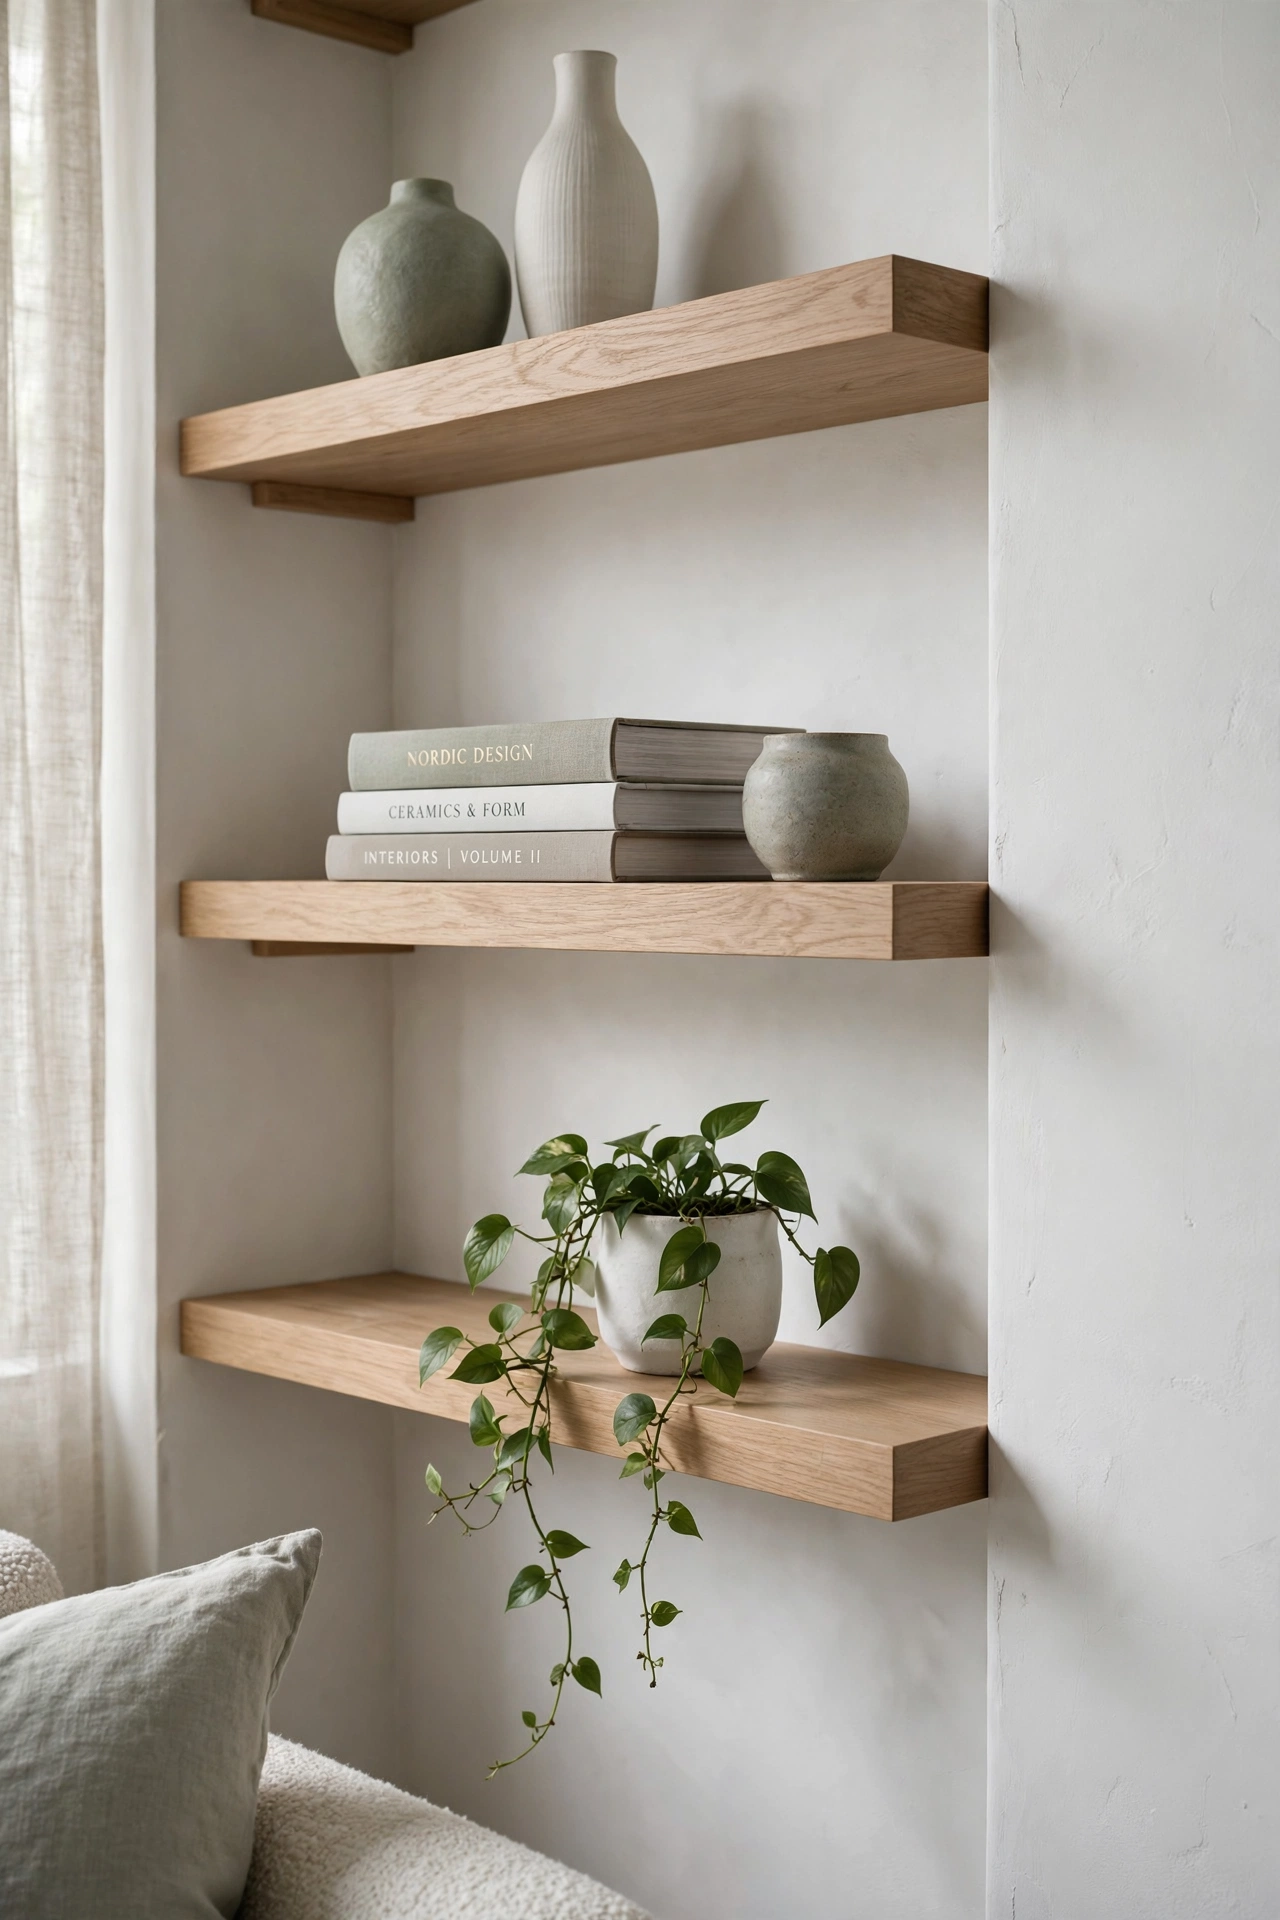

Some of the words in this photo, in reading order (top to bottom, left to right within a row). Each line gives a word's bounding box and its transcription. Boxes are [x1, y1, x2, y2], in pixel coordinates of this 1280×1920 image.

[407, 748, 467, 767] NORDIC
[473, 743, 534, 764] DESIGN
[388, 803, 461, 820] CERAMICS
[466, 803, 476, 818] &
[482, 801, 526, 818] FORM
[364, 850, 439, 865] INTERIORS
[460, 849, 522, 865] VOLUME
